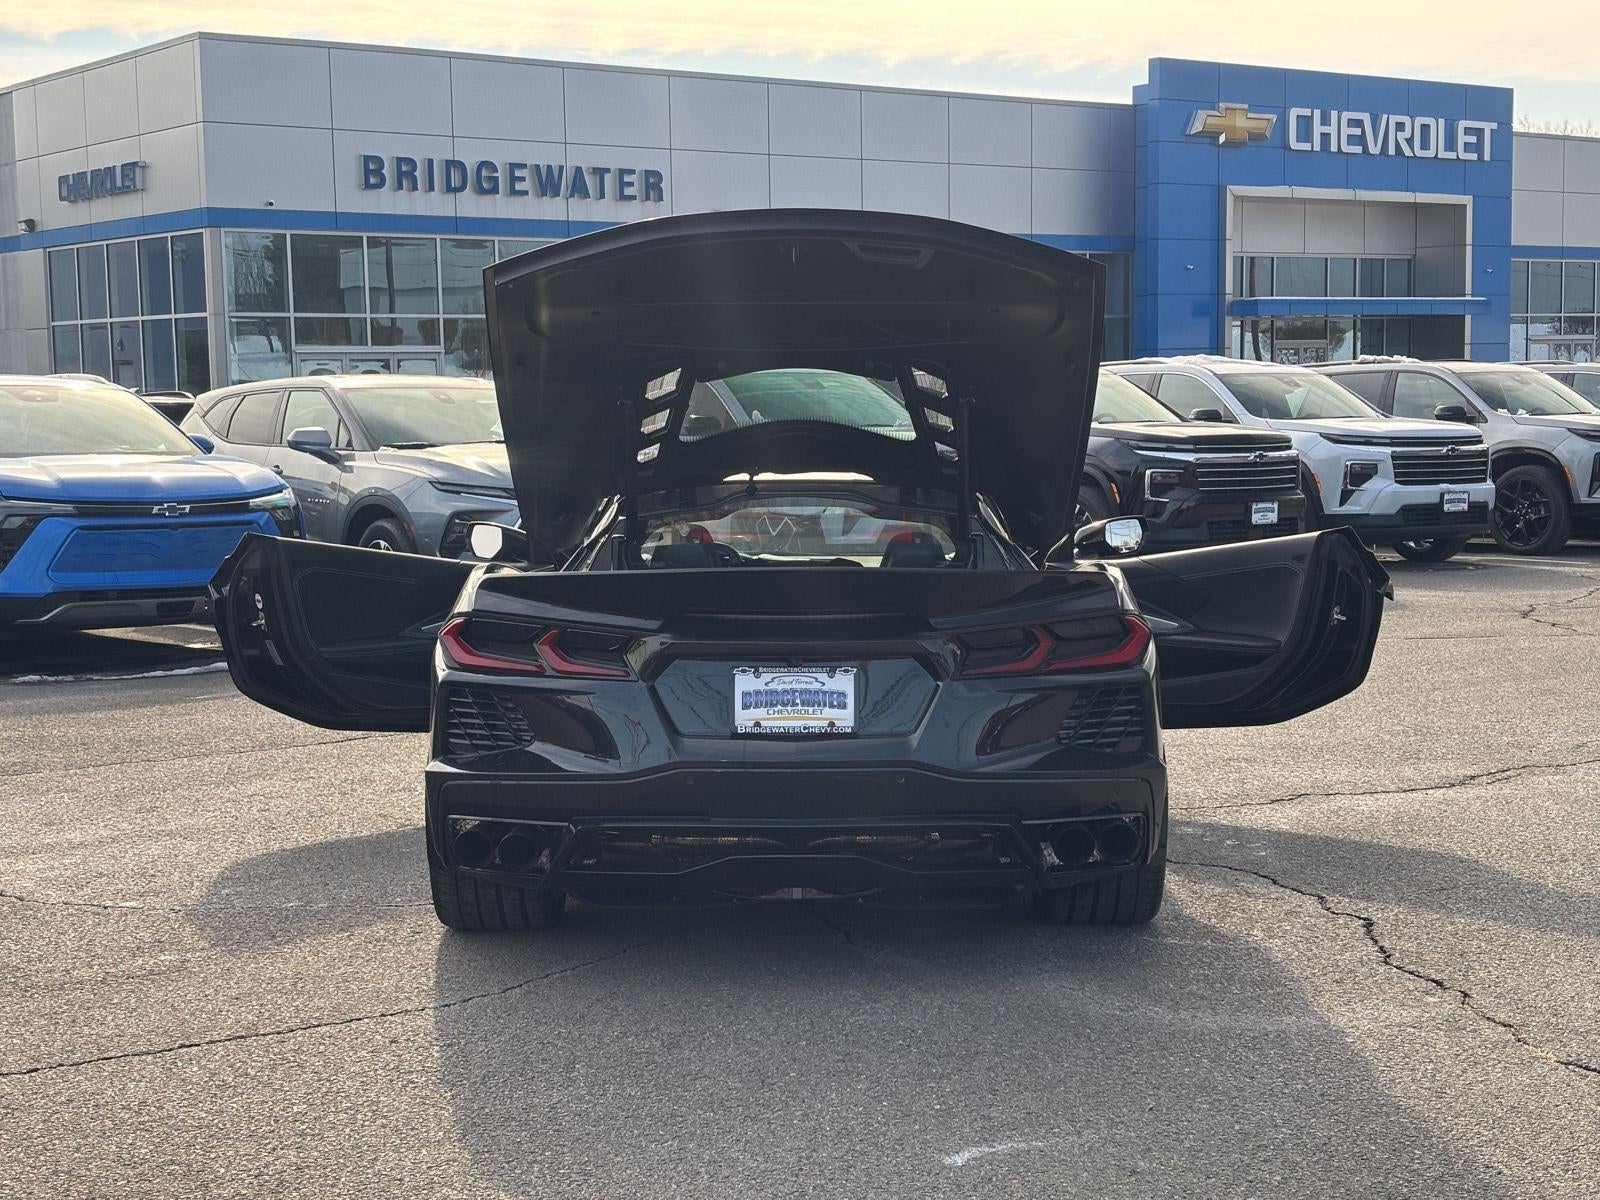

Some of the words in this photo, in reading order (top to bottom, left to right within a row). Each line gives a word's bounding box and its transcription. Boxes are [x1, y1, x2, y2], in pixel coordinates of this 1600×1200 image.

[1287, 107, 1498, 162] CHEVROLET
[58, 161, 147, 203] CHEVROLET
[361, 154, 665, 202] BRIDGEWATER
[741, 688, 849, 710] BRIDGEWATER
